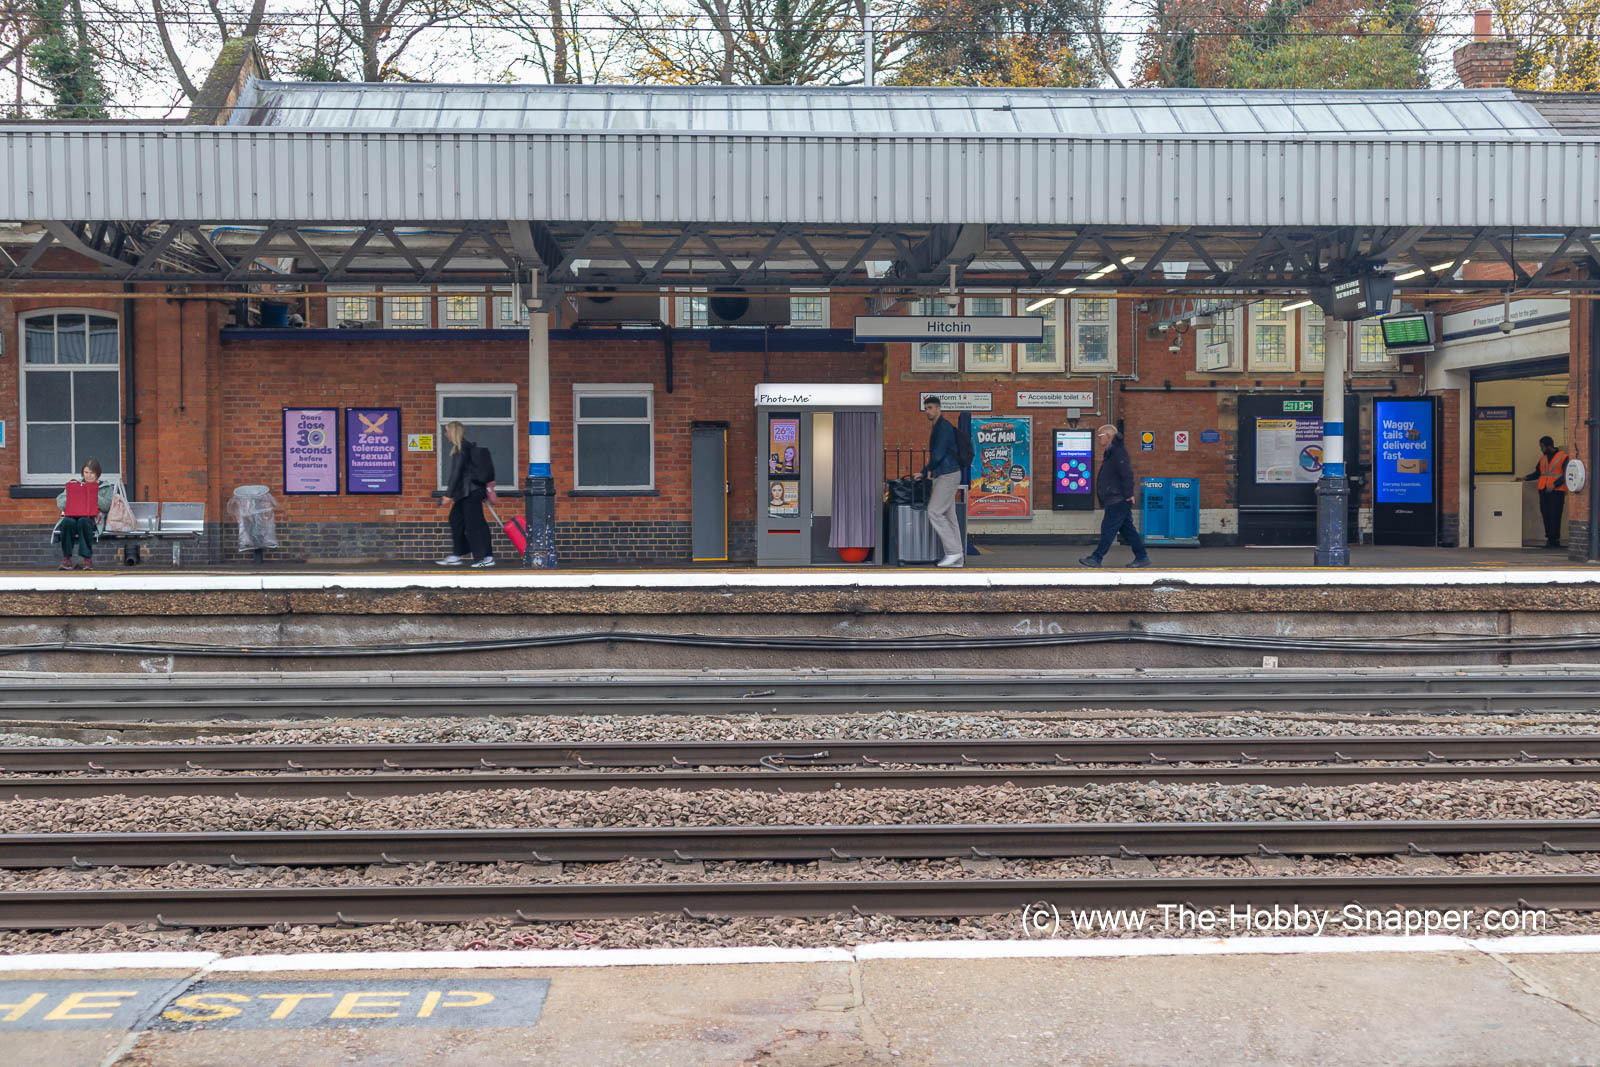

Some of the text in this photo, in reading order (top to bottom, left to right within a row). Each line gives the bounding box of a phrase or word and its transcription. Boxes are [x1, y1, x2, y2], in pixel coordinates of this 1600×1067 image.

[927, 321, 971, 332] Hitchin
[297, 421, 325, 430] close
[1383, 420, 1414, 430] Waggy
[775, 427, 795, 435] 26%
[1383, 430, 1404, 439] tails
[358, 433, 389, 444] Zero
[977, 431, 1016, 443] DOG MAN
[352, 444, 395, 452] tolerance
[1383, 441, 1427, 450] delivered
[289, 446, 333, 455] seconds
[360, 452, 392, 460] sexual
[1383, 451, 1405, 460] fast.
[293, 462, 328, 470] departure
[1144, 481, 1163, 489] METRO
[1172, 481, 1190, 489] METRO
[161, 991, 495, 1021] STEP
